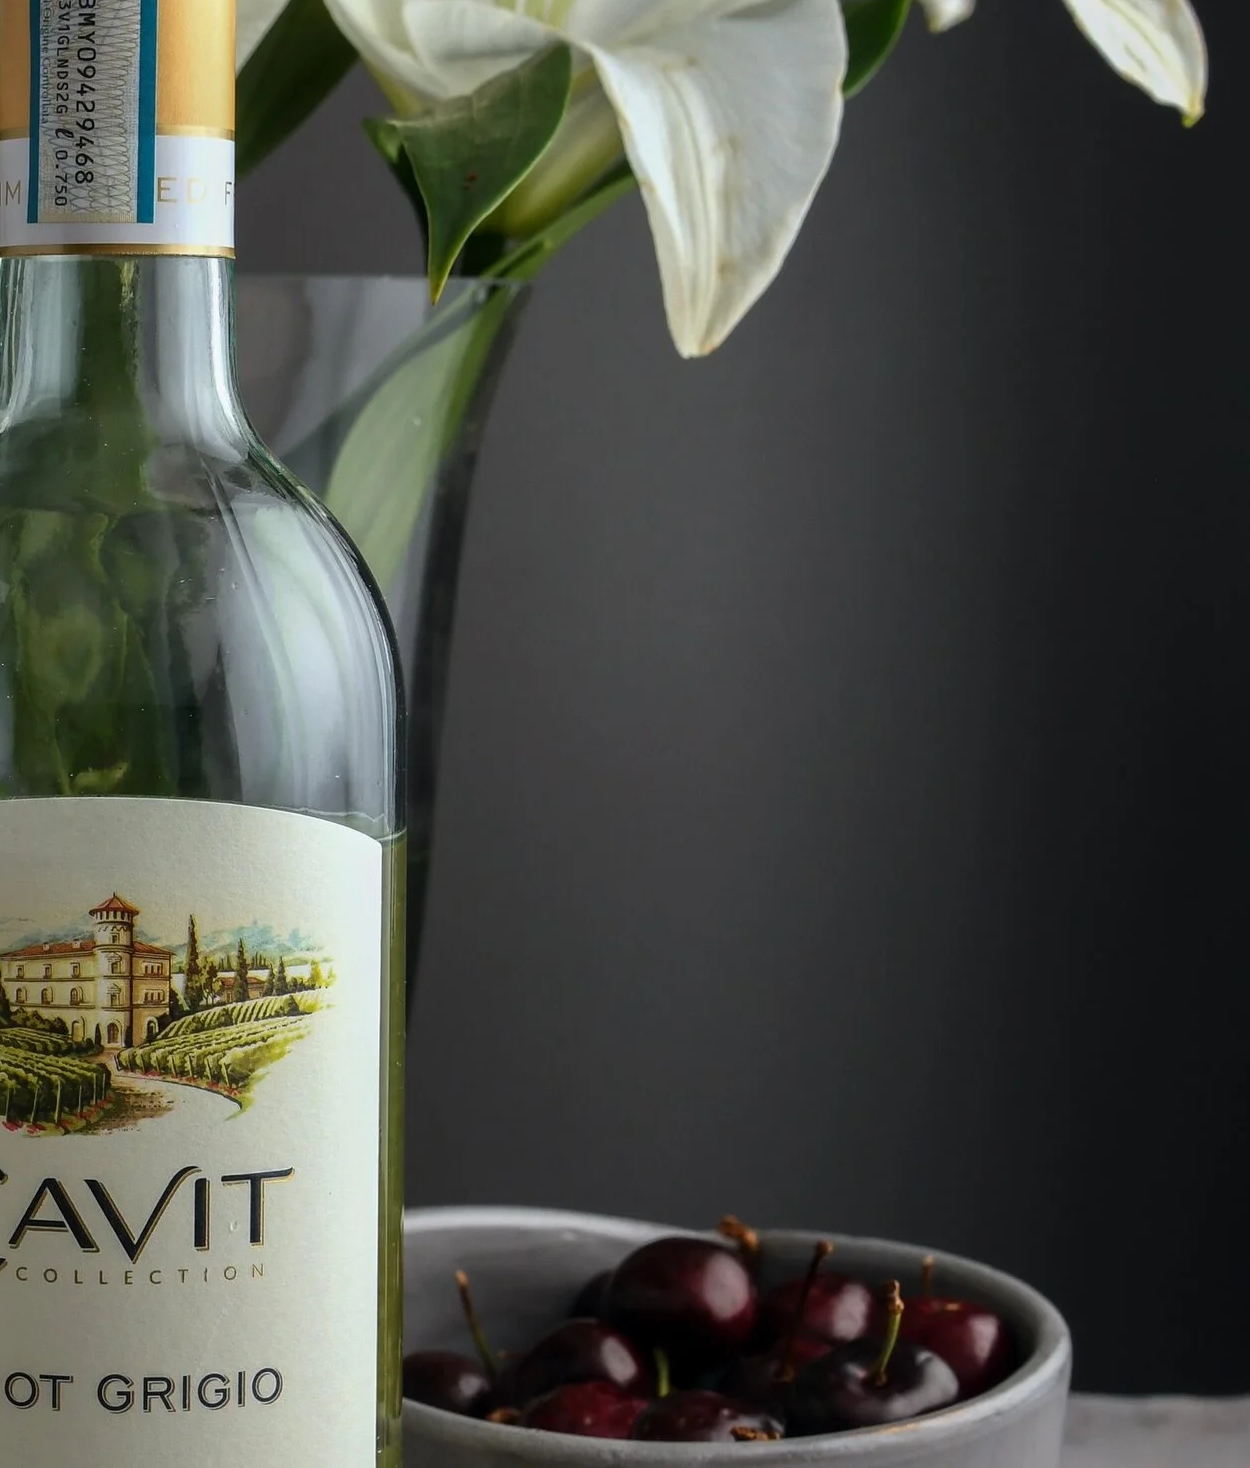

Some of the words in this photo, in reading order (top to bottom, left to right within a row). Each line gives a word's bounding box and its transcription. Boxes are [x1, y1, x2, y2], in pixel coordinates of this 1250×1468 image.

[54, 150, 68, 206] 0.750
[15, 1263, 265, 1285] COLLECTION
[97, 1367, 283, 1414] GRIGIO
